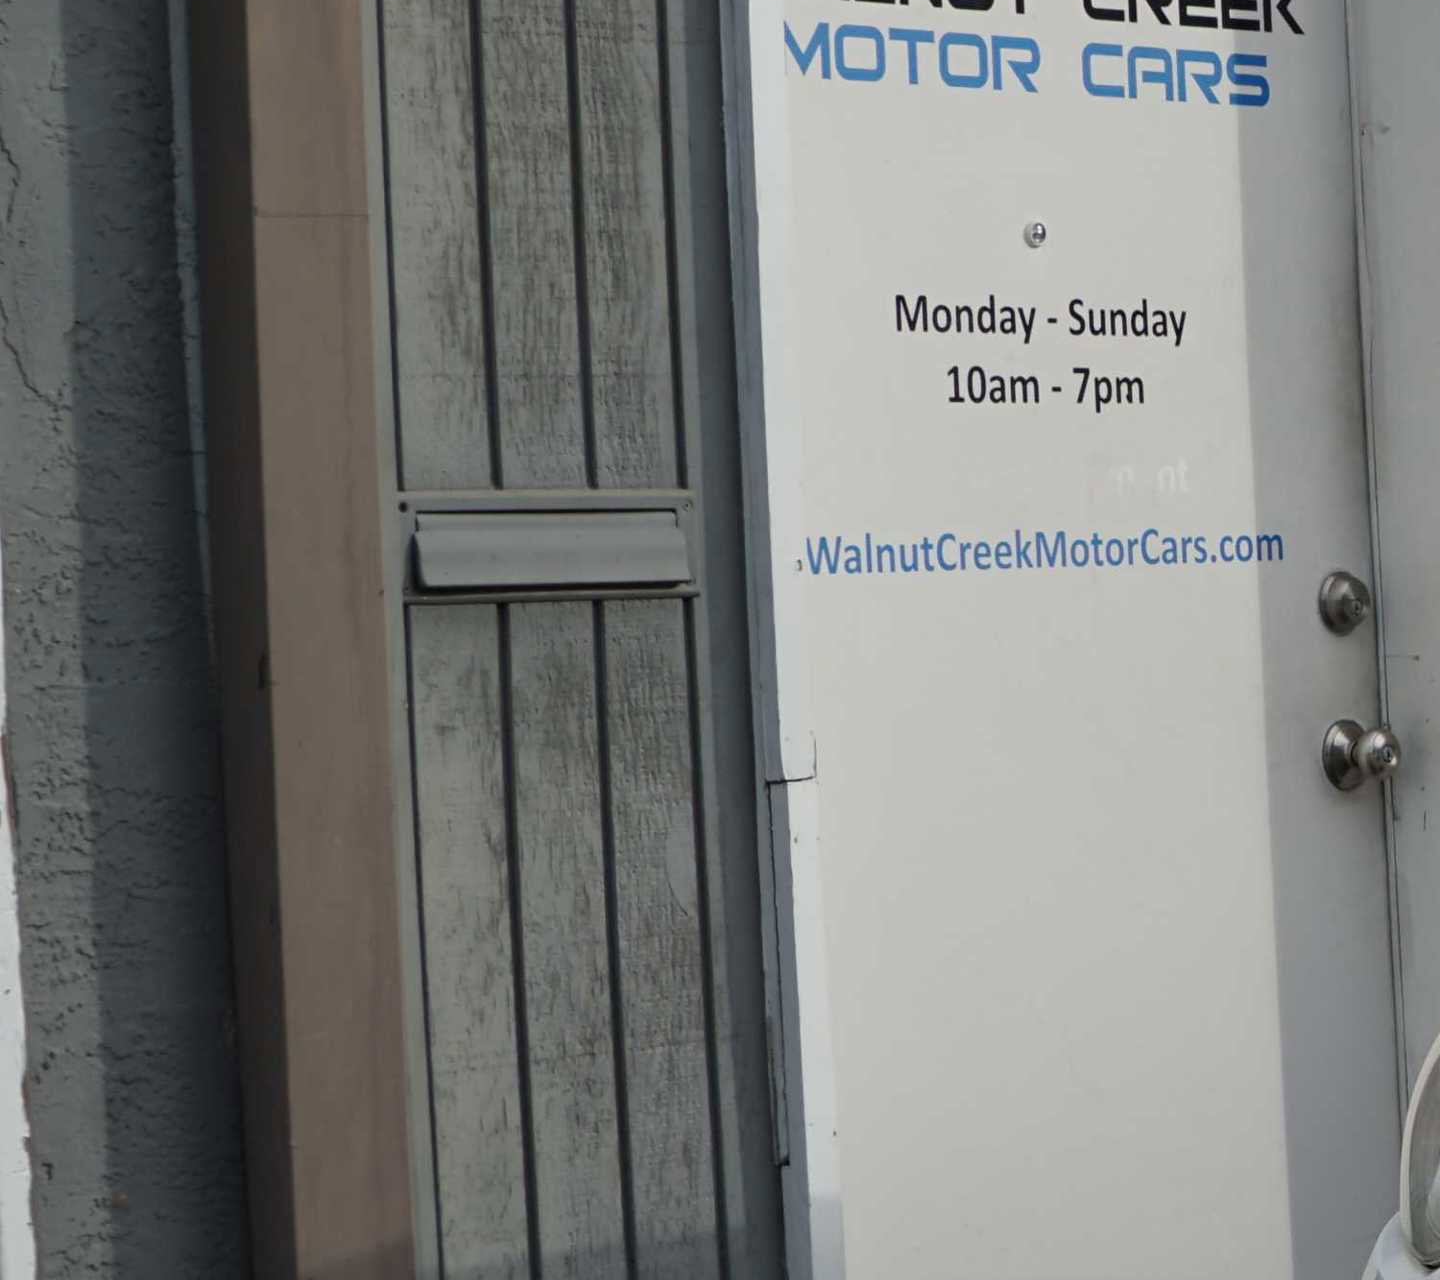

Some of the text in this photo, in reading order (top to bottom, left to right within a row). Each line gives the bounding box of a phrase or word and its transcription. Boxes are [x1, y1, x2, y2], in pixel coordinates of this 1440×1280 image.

[783, 21, 1272, 109] MOTOR CARS
[895, 293, 1036, 345] Monday
[1068, 298, 1188, 347] Sunday
[947, 365, 1041, 404] 10am
[1072, 367, 1145, 414] 7pm
[805, 530, 1286, 577] WalnutCreekMotorCars.com
